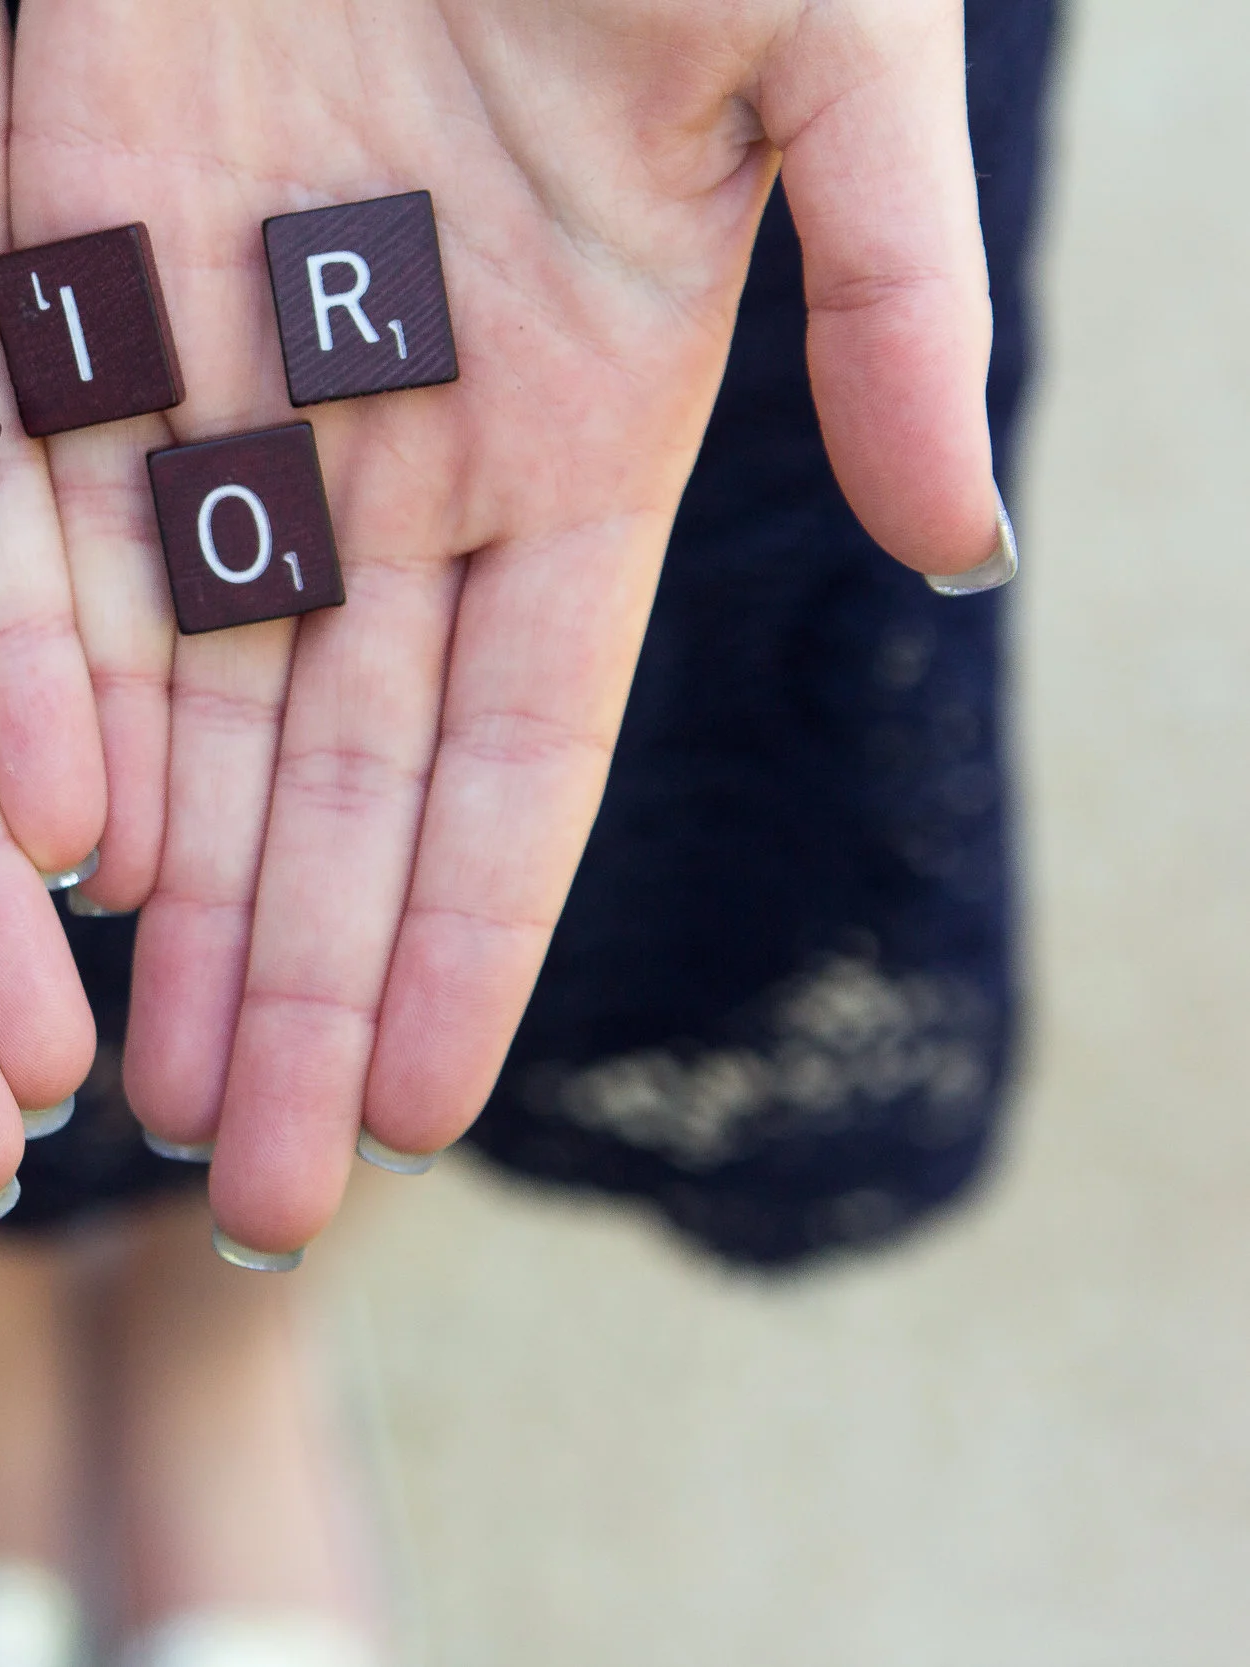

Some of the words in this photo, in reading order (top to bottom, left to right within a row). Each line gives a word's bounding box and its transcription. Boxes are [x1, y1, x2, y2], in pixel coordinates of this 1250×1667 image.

[31, 271, 51, 311] 1
[59, 285, 93, 382] I
[306, 250, 381, 352] R
[387, 319, 407, 360] 1
[197, 484, 273, 584] O
[283, 551, 303, 591] 1
